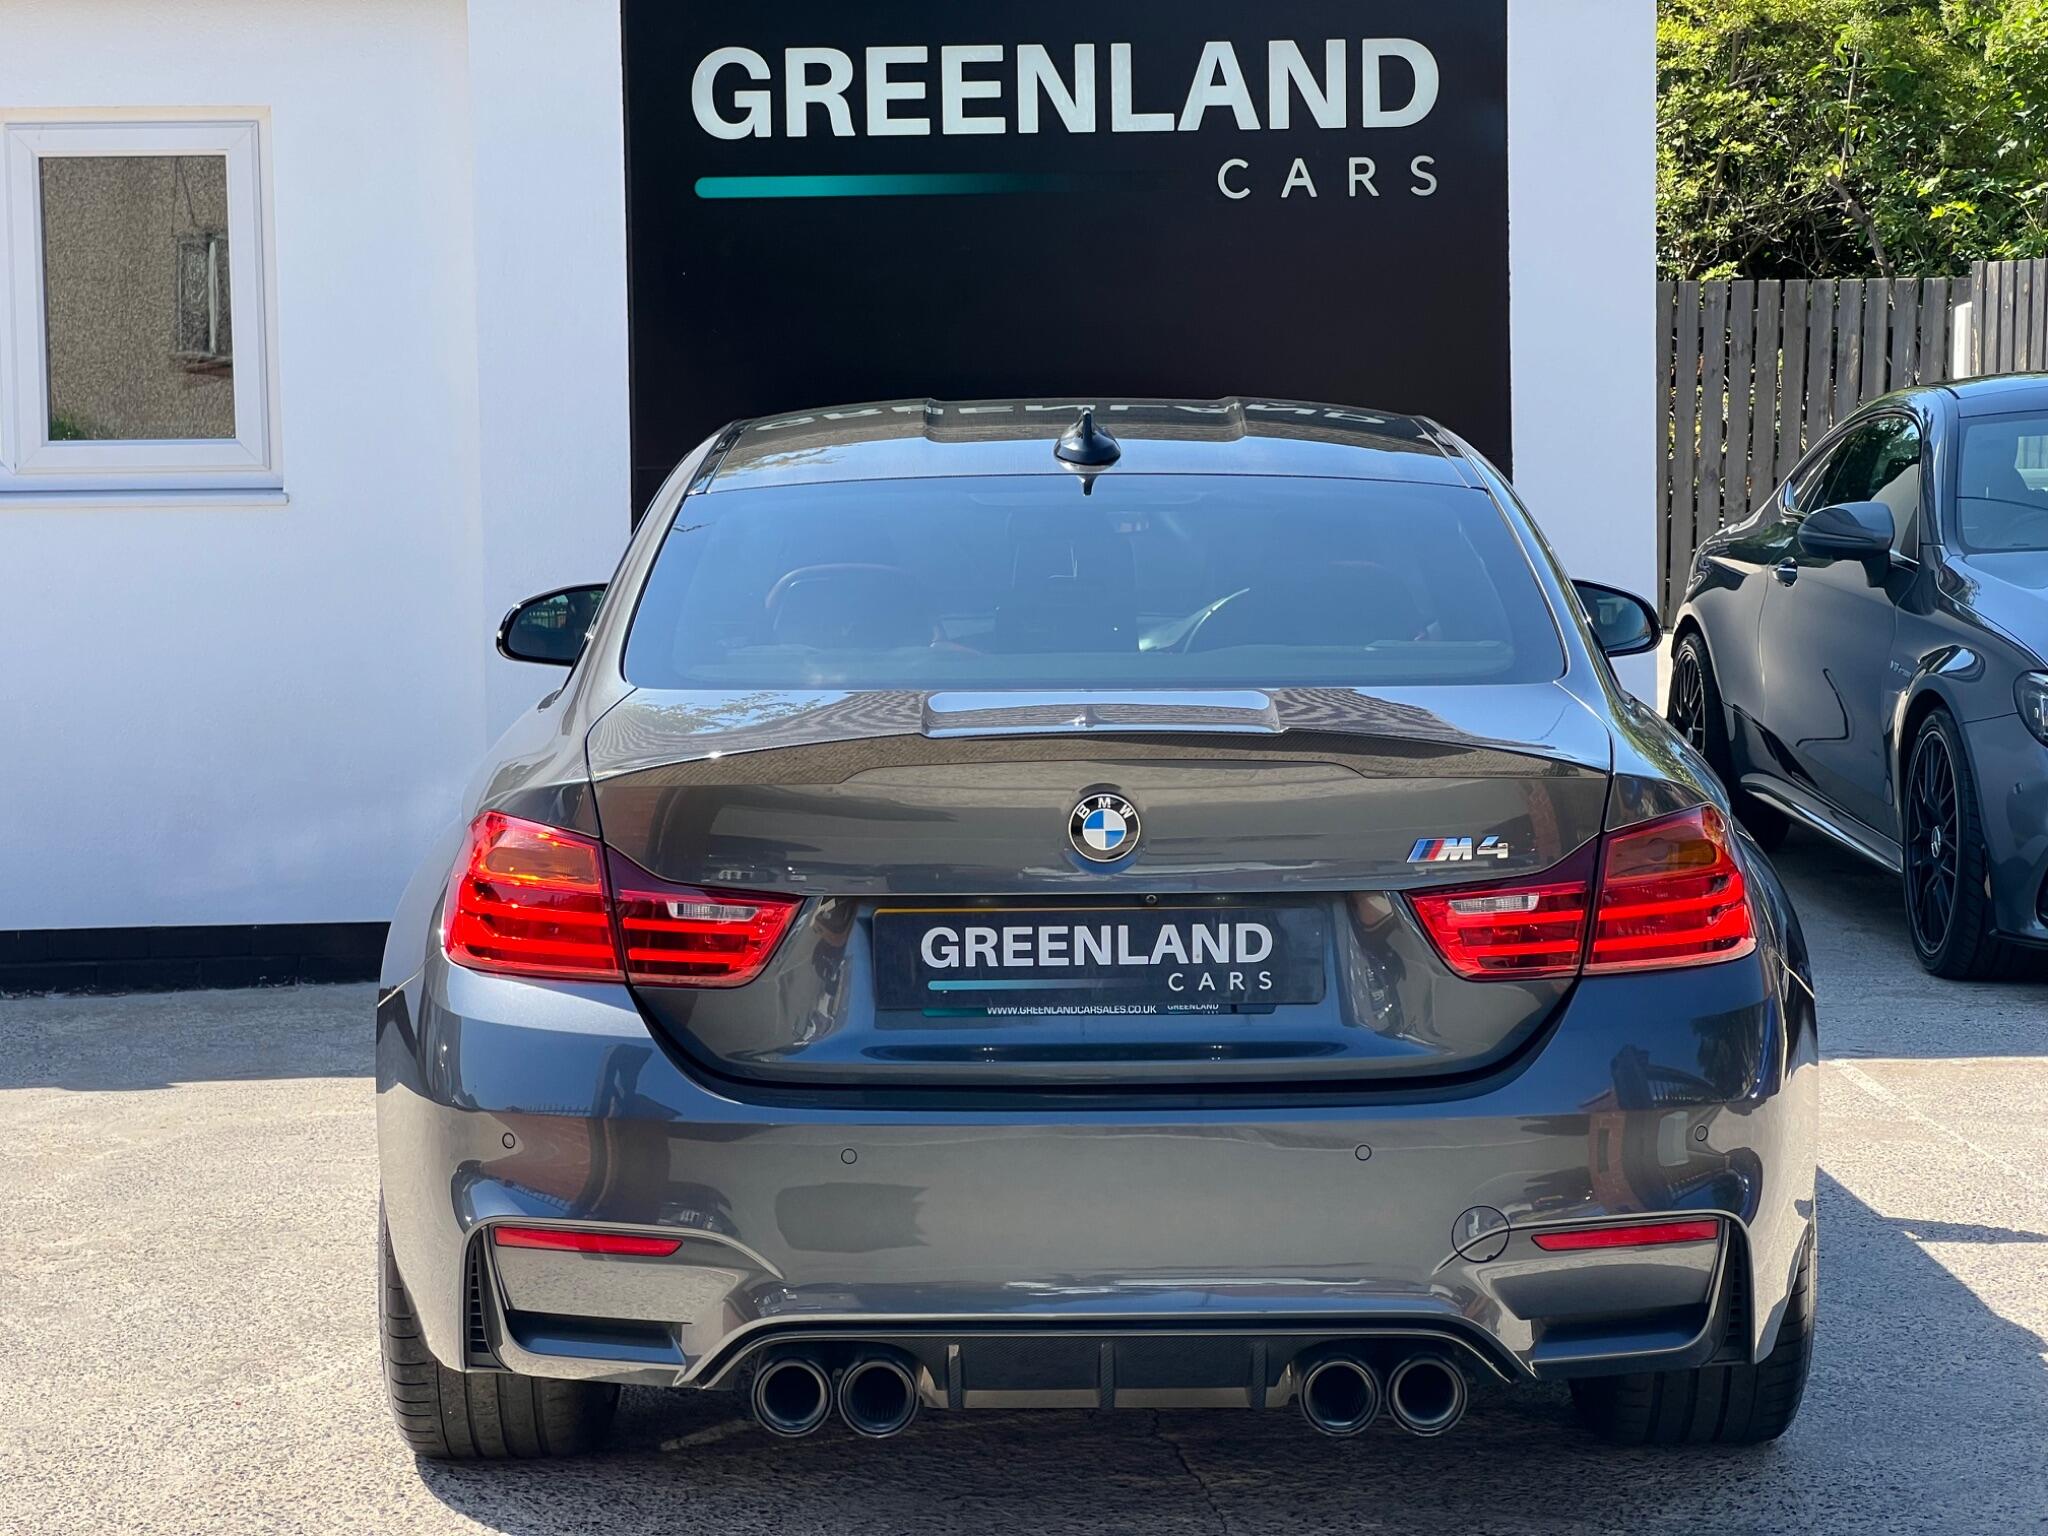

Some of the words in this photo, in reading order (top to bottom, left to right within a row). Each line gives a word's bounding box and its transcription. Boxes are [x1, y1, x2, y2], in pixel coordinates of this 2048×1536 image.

[692, 38, 1439, 139] GREENLAND
[1217, 155, 1438, 199] CARS
[1076, 797, 1134, 819] BMW
[1407, 835, 1509, 862] M4
[920, 923, 1273, 968] GREENLAND
[1168, 971, 1272, 992] CARS
[987, 1005, 1157, 1015] WWW.GREENLANDCARSALES.CO.UK
